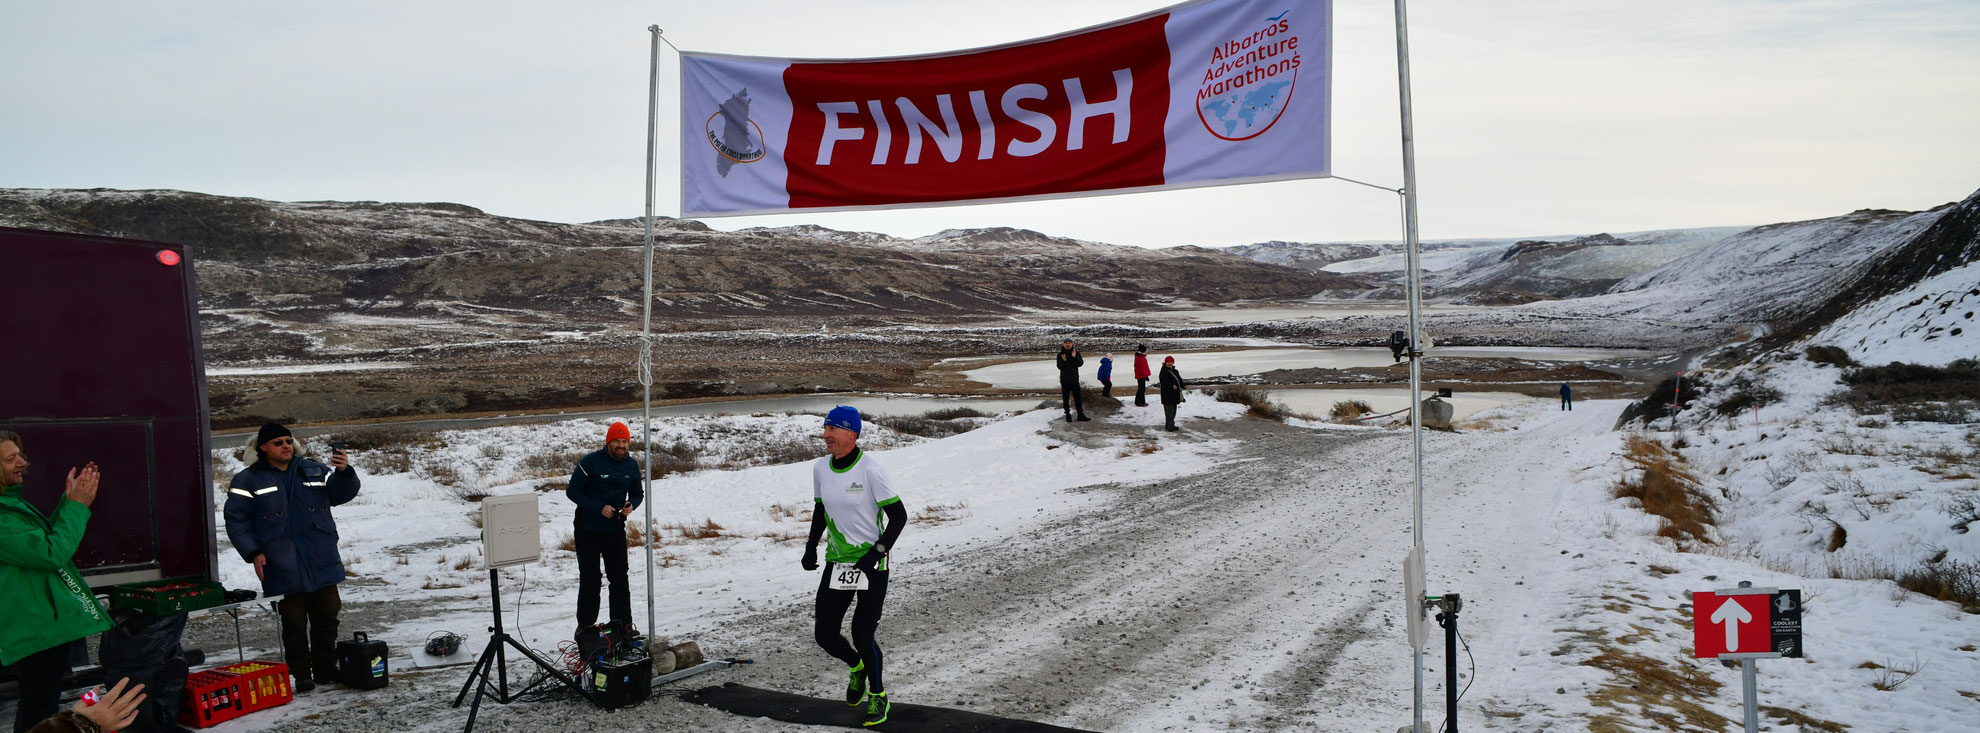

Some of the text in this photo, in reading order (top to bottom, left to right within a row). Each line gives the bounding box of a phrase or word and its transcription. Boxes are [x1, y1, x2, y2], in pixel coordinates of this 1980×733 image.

[1202, 36, 1298, 86] Adventure
[1211, 19, 1289, 65] Albatros
[1199, 54, 1301, 100] Marathons
[815, 68, 1134, 165] FINISH
[713, 138, 728, 153] POLAR
[837, 570, 861, 584] 437
[81, 592, 101, 620] ARCTIC
